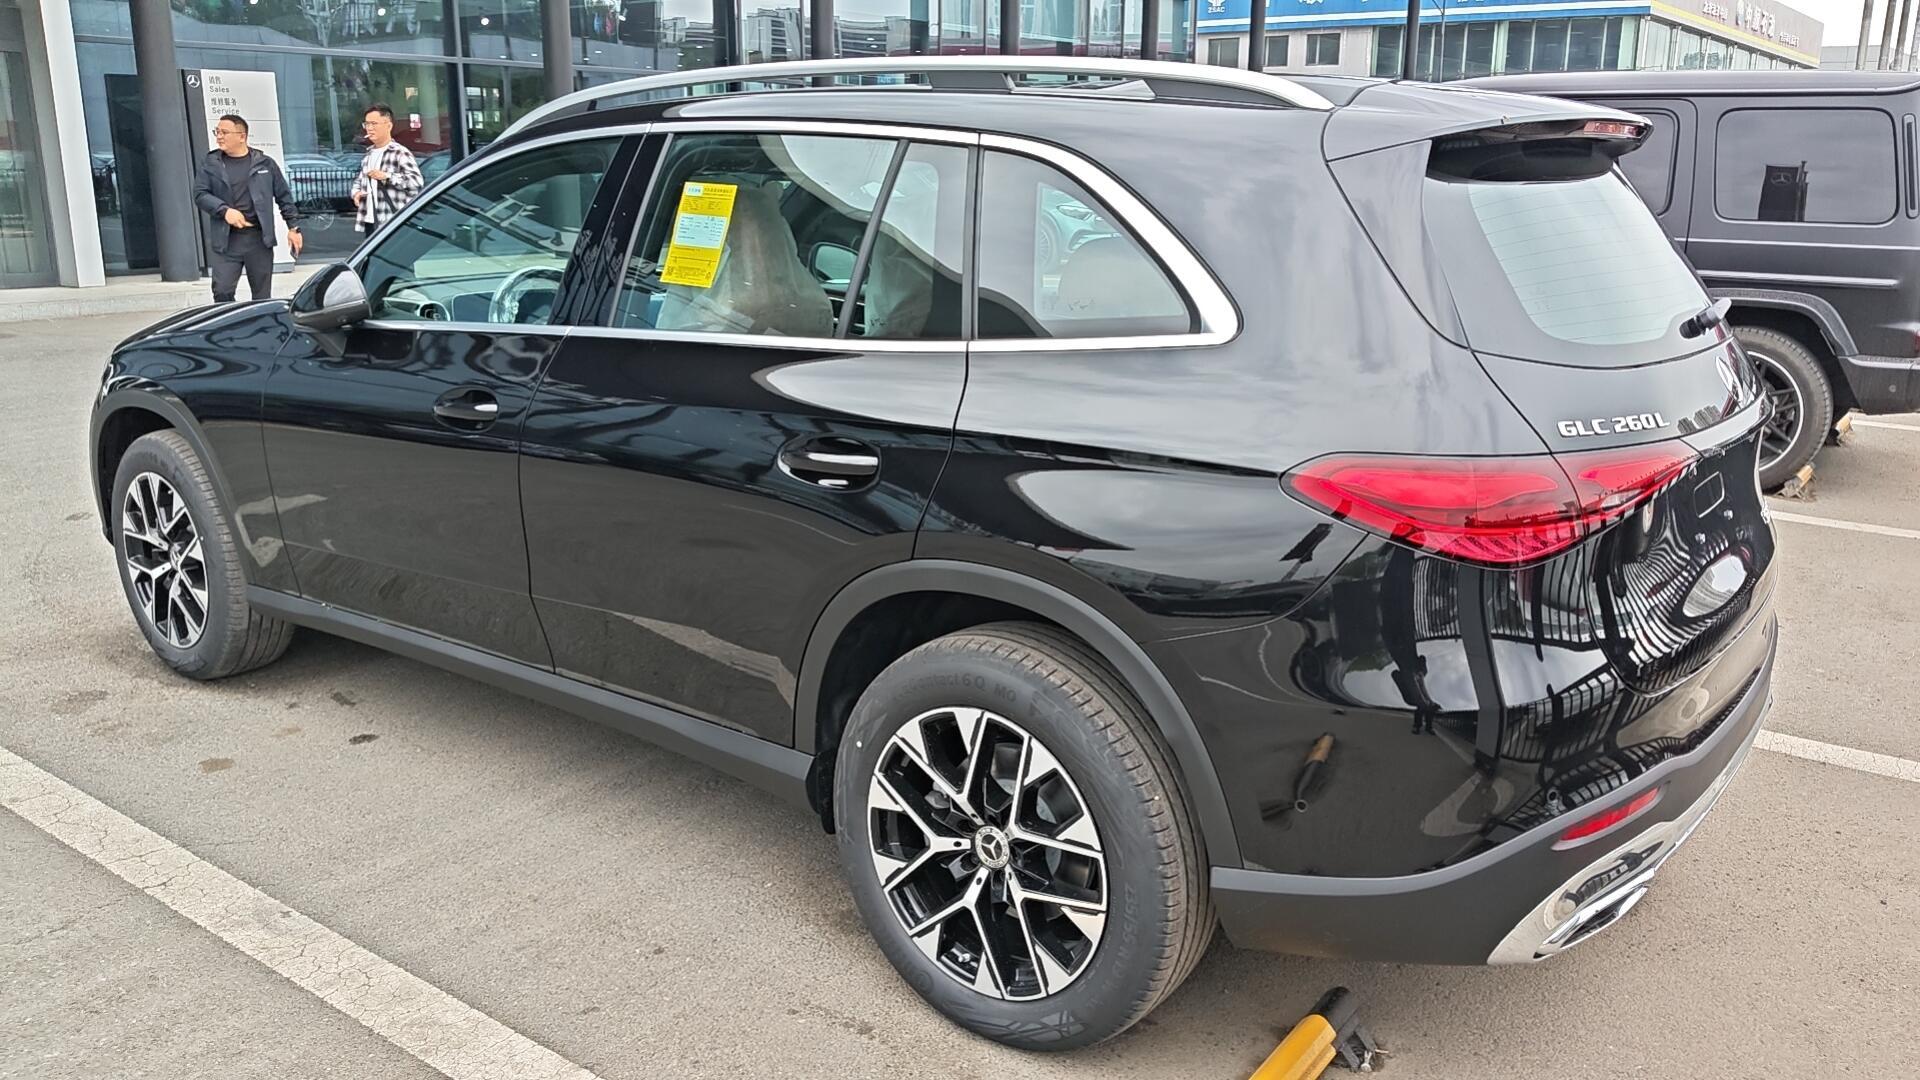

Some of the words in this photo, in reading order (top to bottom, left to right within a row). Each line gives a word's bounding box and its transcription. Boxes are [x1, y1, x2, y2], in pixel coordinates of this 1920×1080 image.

[212, 106, 240, 114] Service
[1557, 418, 1610, 437] GLC
[1611, 411, 1671, 434] 260L
